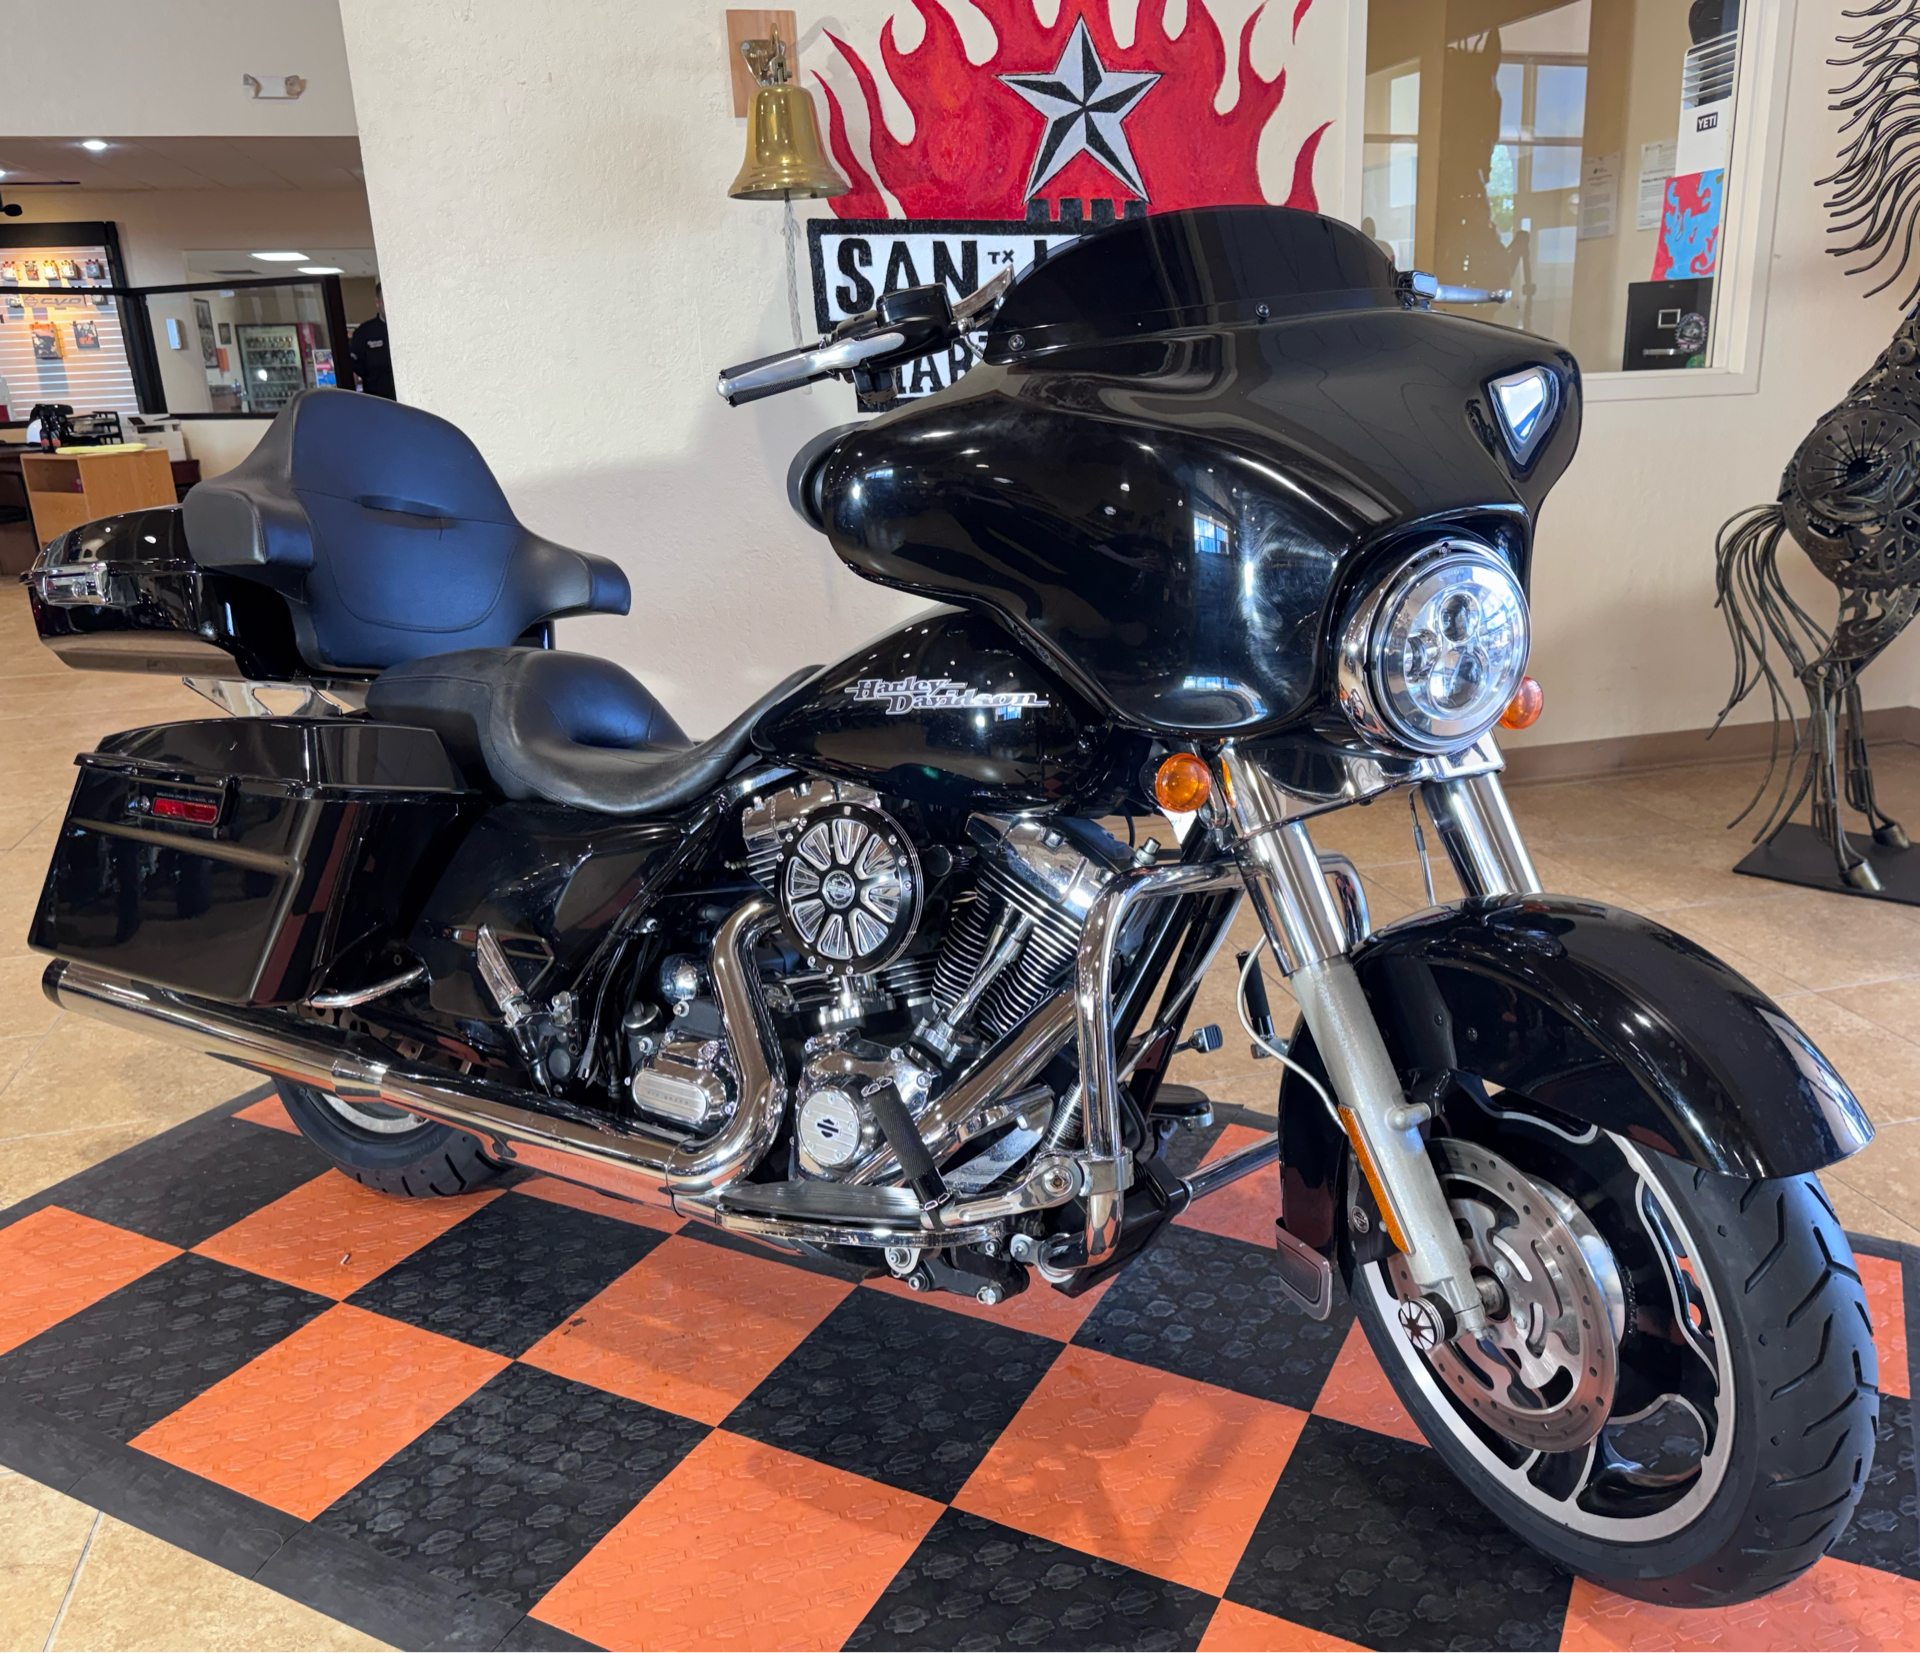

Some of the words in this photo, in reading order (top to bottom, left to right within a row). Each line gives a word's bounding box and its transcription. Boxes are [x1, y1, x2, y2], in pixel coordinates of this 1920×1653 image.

[1698, 115, 1717, 130] YETI
[836, 238, 978, 314] SAN
[987, 249, 1015, 265] TX
[41, 297, 82, 306] CVO
[848, 676, 964, 702] Harley
[886, 688, 1050, 715] Davidson
